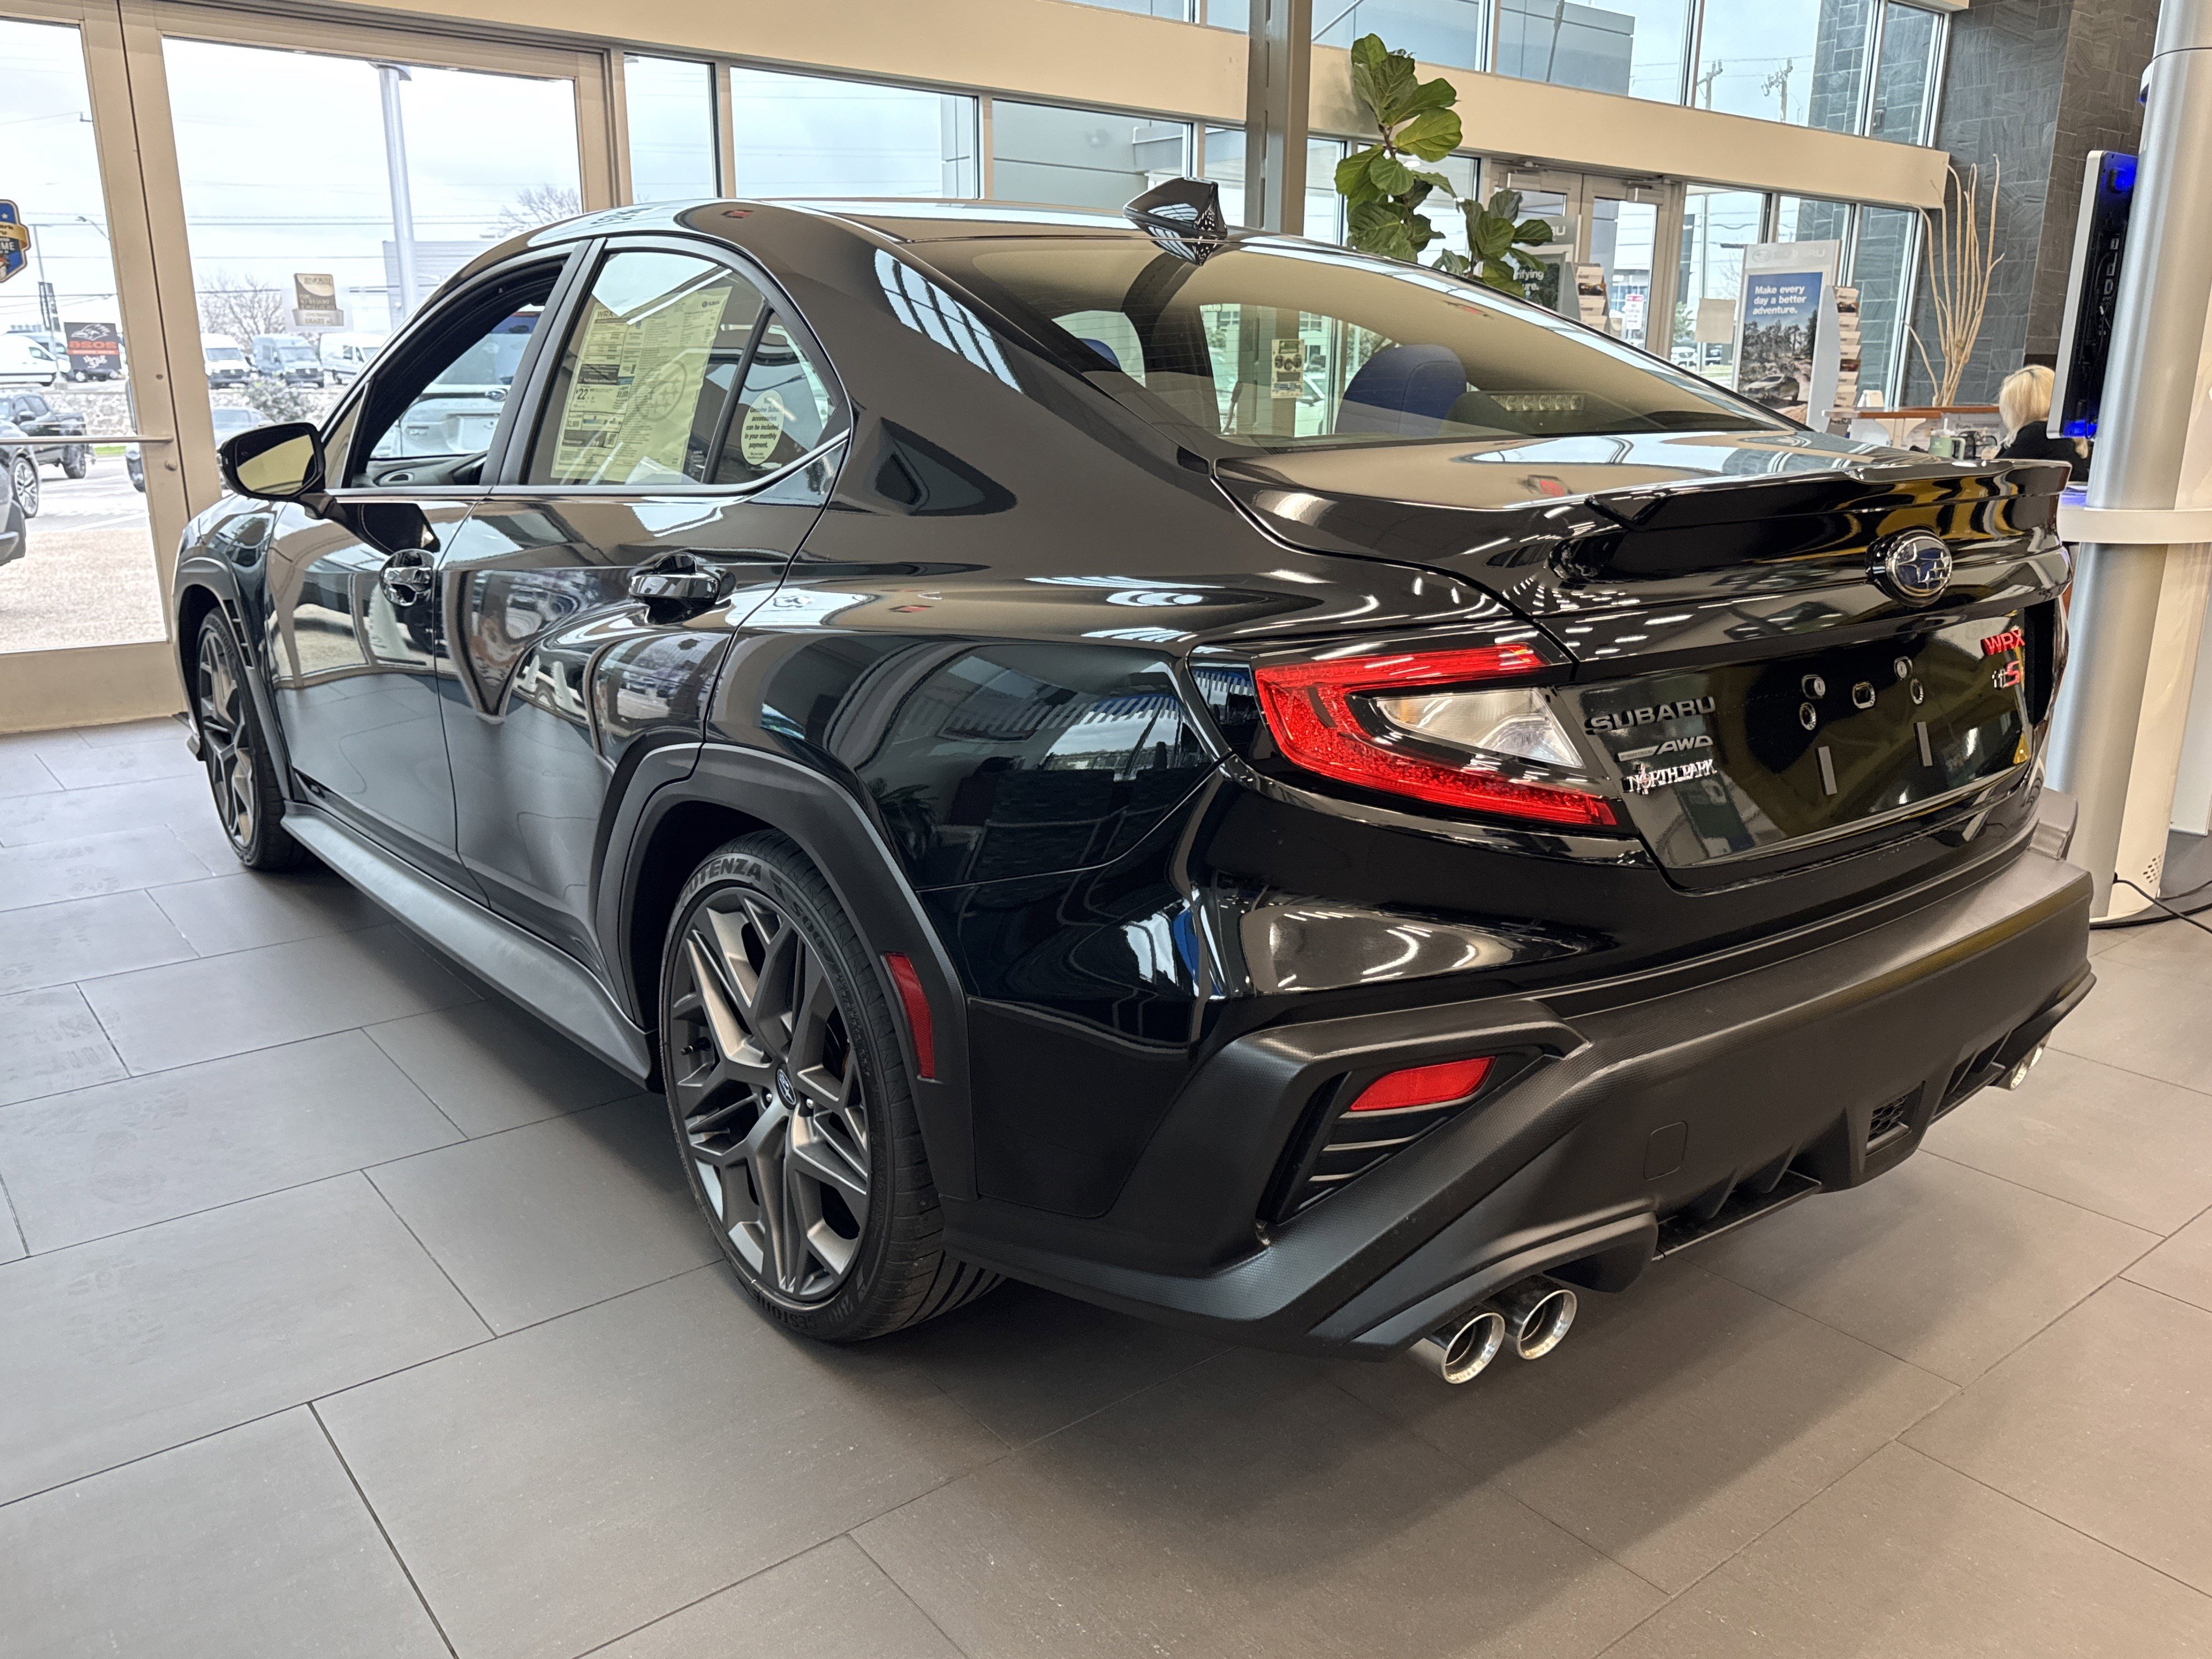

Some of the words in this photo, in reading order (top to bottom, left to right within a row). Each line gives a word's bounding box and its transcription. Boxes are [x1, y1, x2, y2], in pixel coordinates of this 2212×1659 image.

[1755, 286, 1777, 295] Make
[1780, 285, 1805, 295] every
[1754, 297, 1768, 306] day
[1779, 295, 1807, 304] better
[1753, 306, 1798, 315] adventure.
[577, 388, 588, 400] 22
[1980, 629, 2025, 656] WRX
[1587, 696, 1716, 734] SUBARU
[1656, 735, 1713, 755] AWD
[1626, 764, 1679, 794] NORTH
[1680, 759, 1718, 781] PARK
